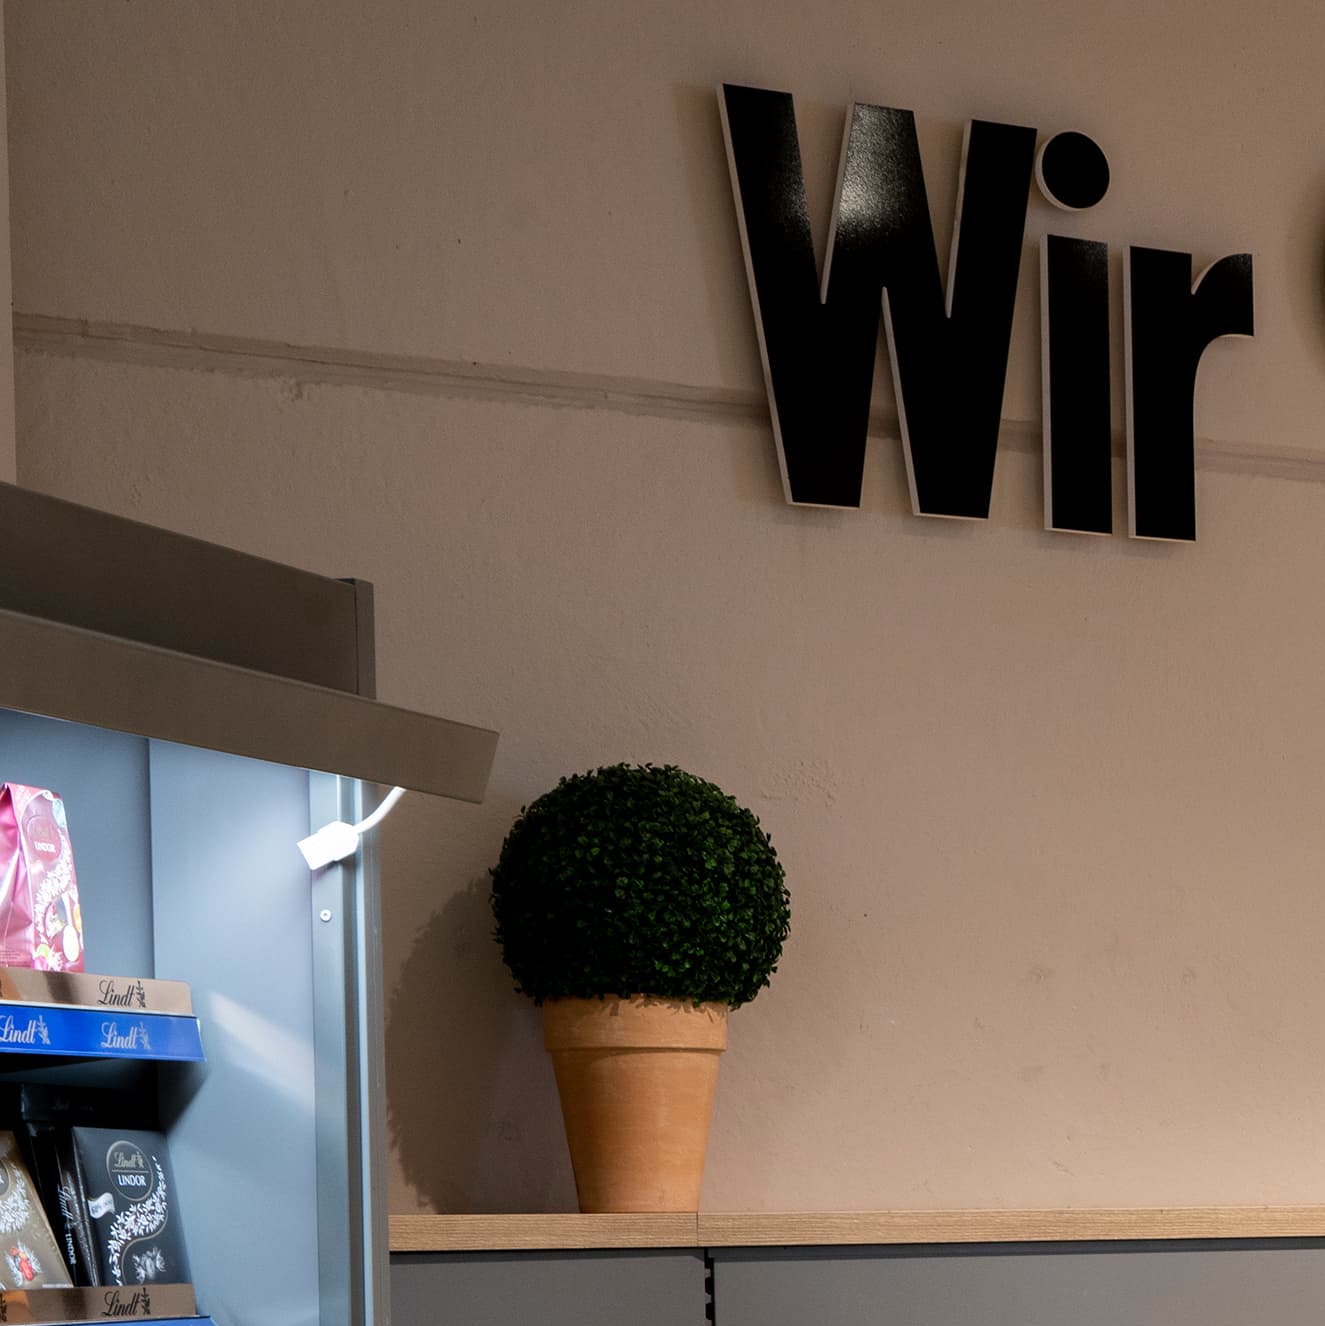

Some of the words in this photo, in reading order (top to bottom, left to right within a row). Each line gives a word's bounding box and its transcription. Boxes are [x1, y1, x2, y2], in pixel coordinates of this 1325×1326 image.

[717, 82, 1255, 541] Wir
[97, 979, 136, 1007] Lindt
[101, 1022, 138, 1050] Lindt
[114, 1152, 136, 1168] Lindt
[117, 1174, 147, 1187] LINDOR
[101, 1291, 140, 1317] Lindt
